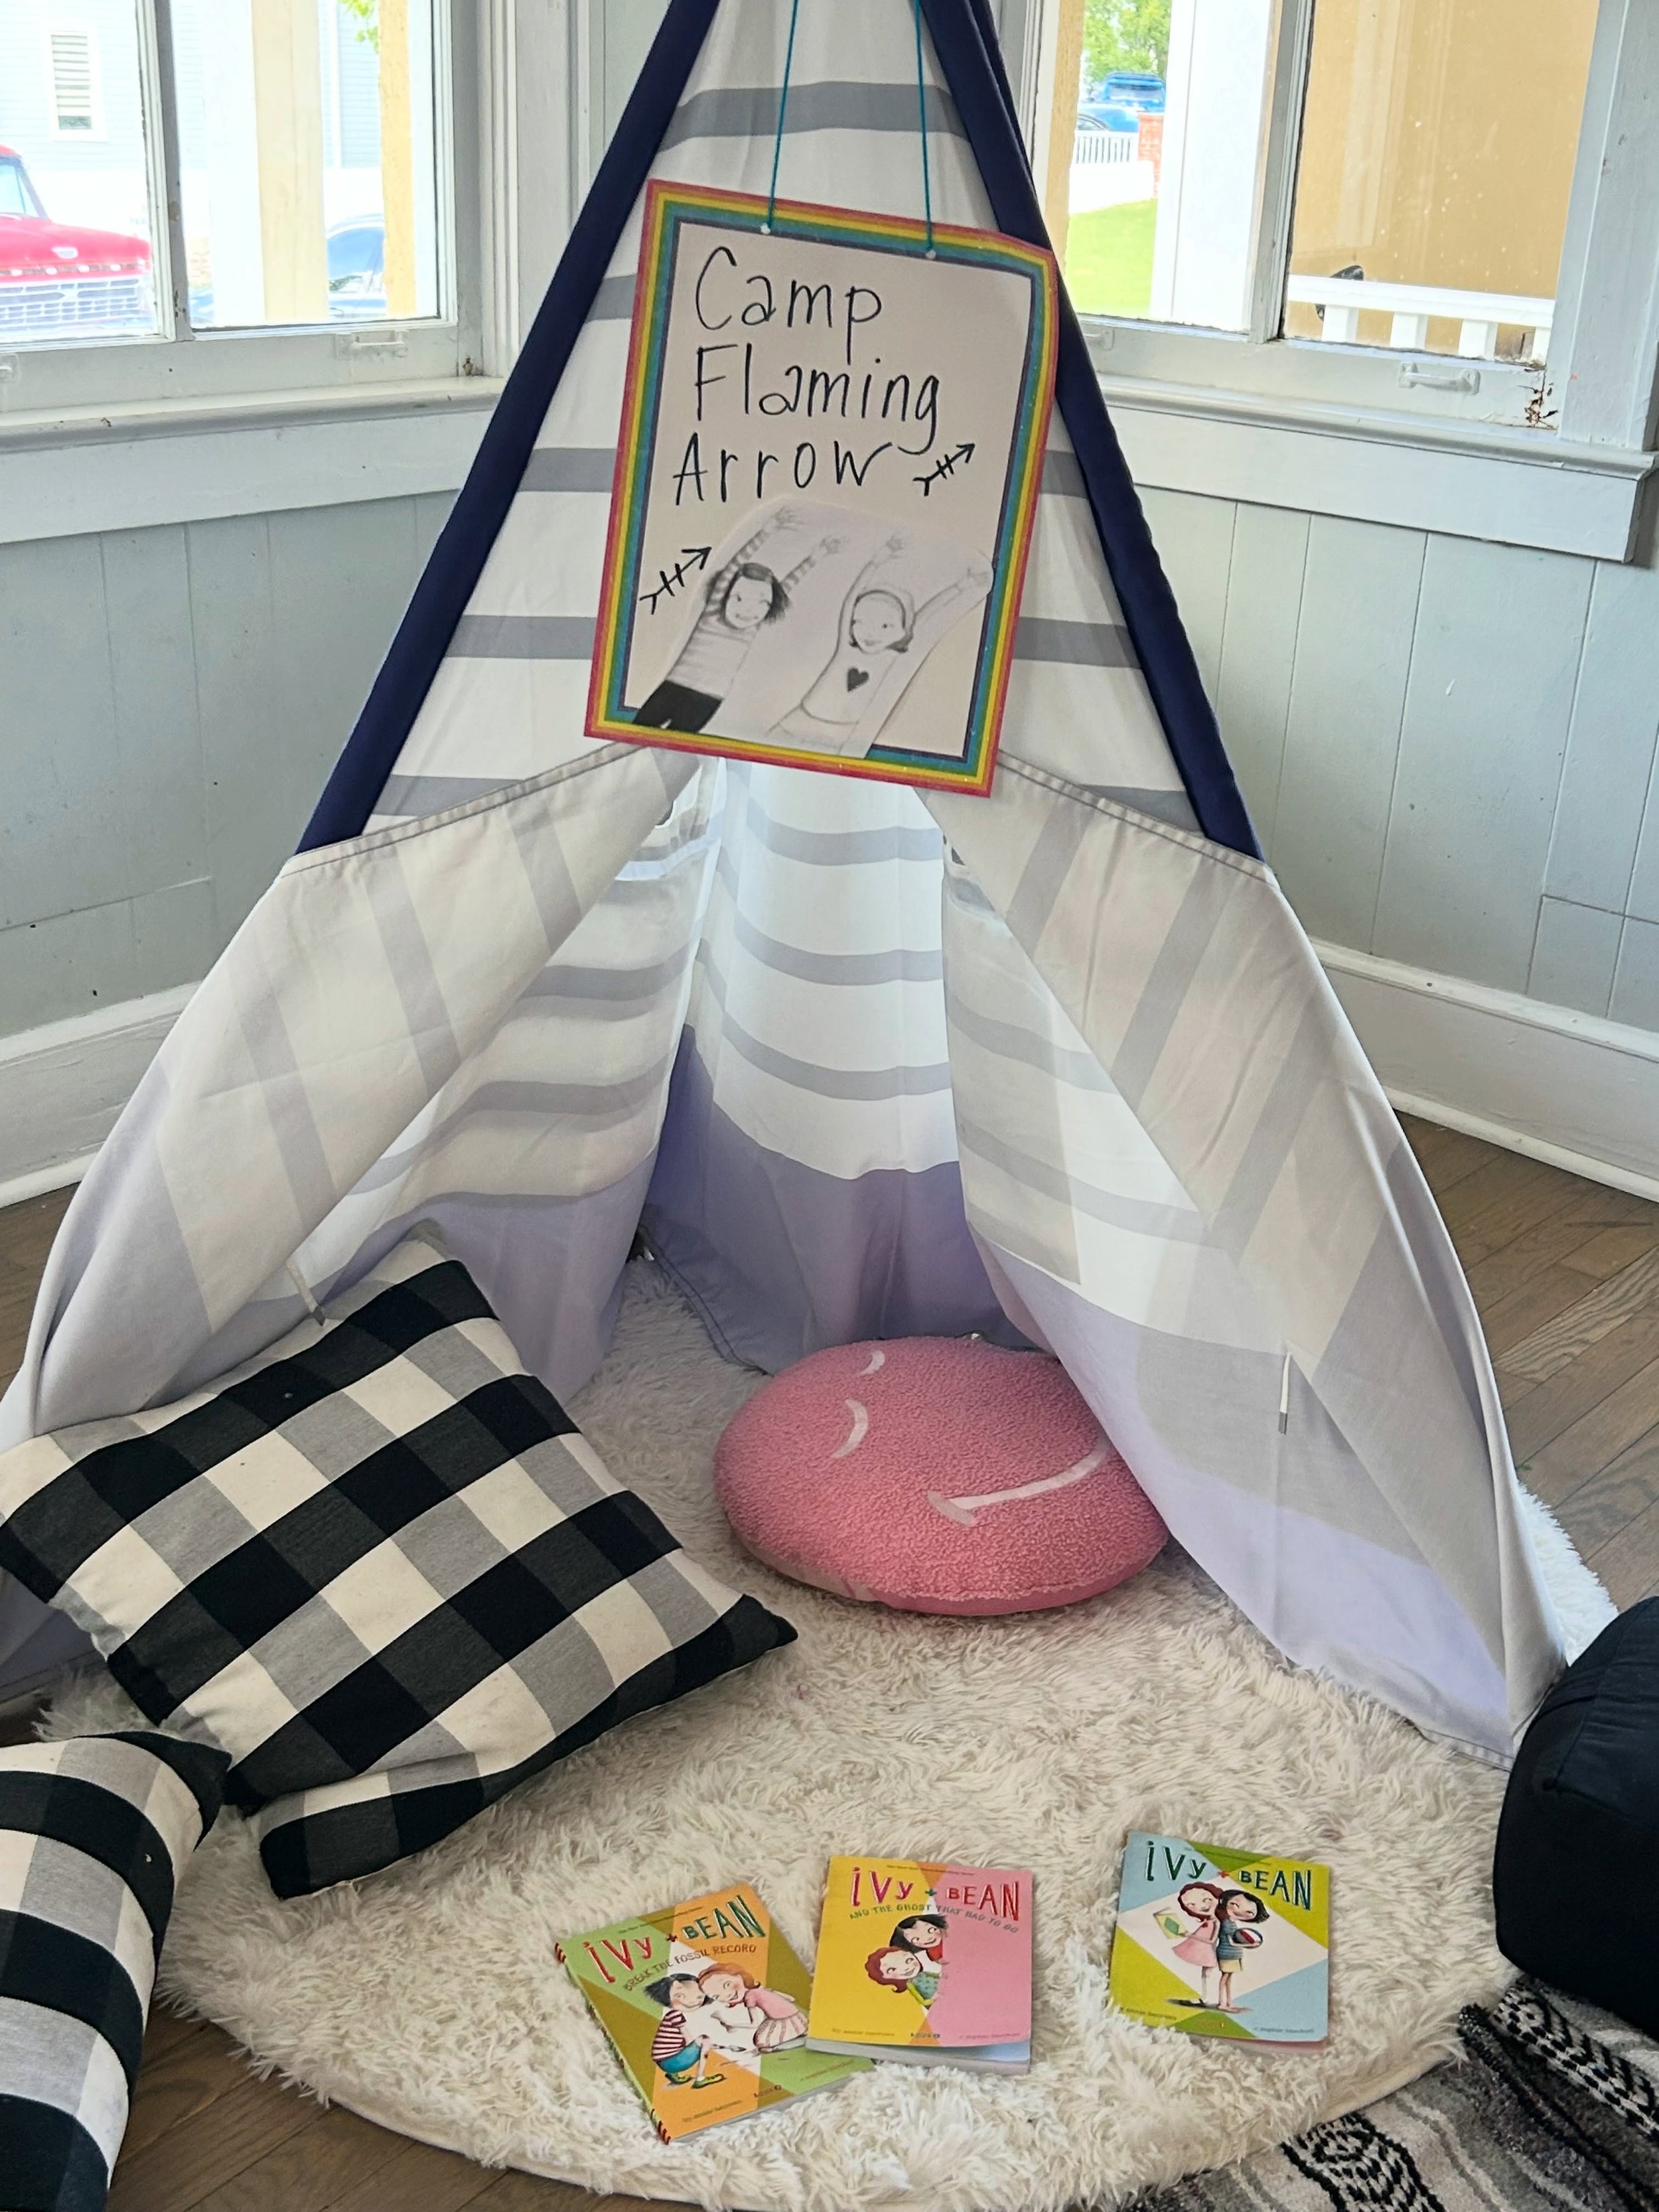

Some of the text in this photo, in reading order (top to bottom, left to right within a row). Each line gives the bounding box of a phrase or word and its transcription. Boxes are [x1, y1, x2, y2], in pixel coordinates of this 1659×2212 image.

[695, 246, 882, 365] Camp
[695, 342, 940, 455] Flaming
[672, 432, 893, 506] Arrow
[946, 1881, 1020, 1921] BEAN
[1238, 1870, 1312, 1911] BEAN
[682, 1894, 766, 1939] BEAN
[849, 1909, 869, 1920] AND
[873, 1905, 892, 1914] THE
[936, 1905, 962, 1915] THAT
[965, 1911, 985, 1921] HAD
[989, 1917, 1001, 1927] TO
[622, 1943, 757, 1991] BREAK THE FOSSIL RECORD
